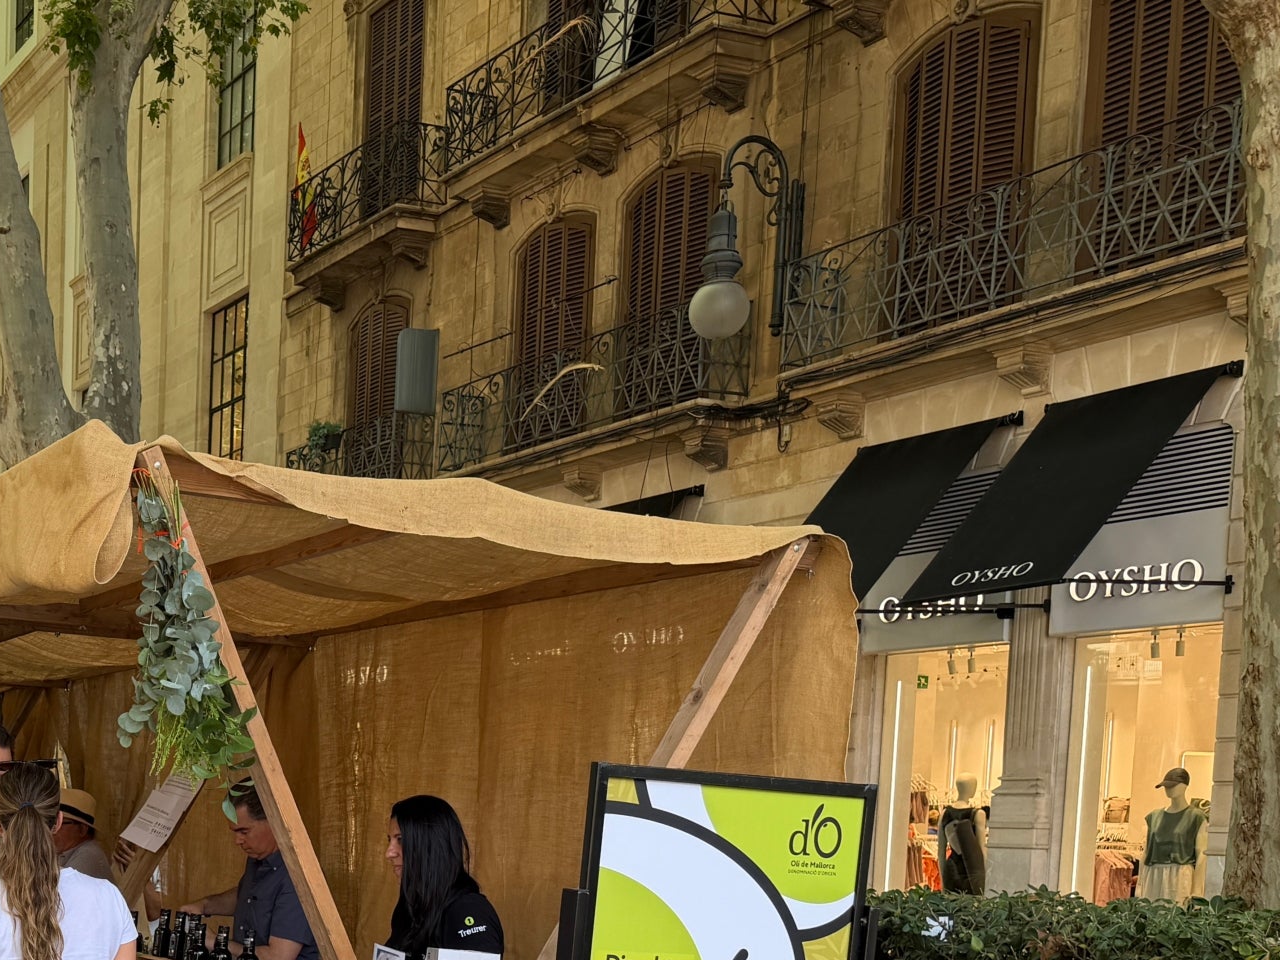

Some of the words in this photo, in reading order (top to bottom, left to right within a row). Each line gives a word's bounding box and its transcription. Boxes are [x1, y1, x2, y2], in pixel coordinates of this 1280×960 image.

[951, 561, 1034, 586] OYSHO
[1069, 558, 1203, 602] OYSHO
[801, 860, 809, 868] de
[810, 861, 836, 870] Mallorca
[457, 924, 487, 938] Treurer
